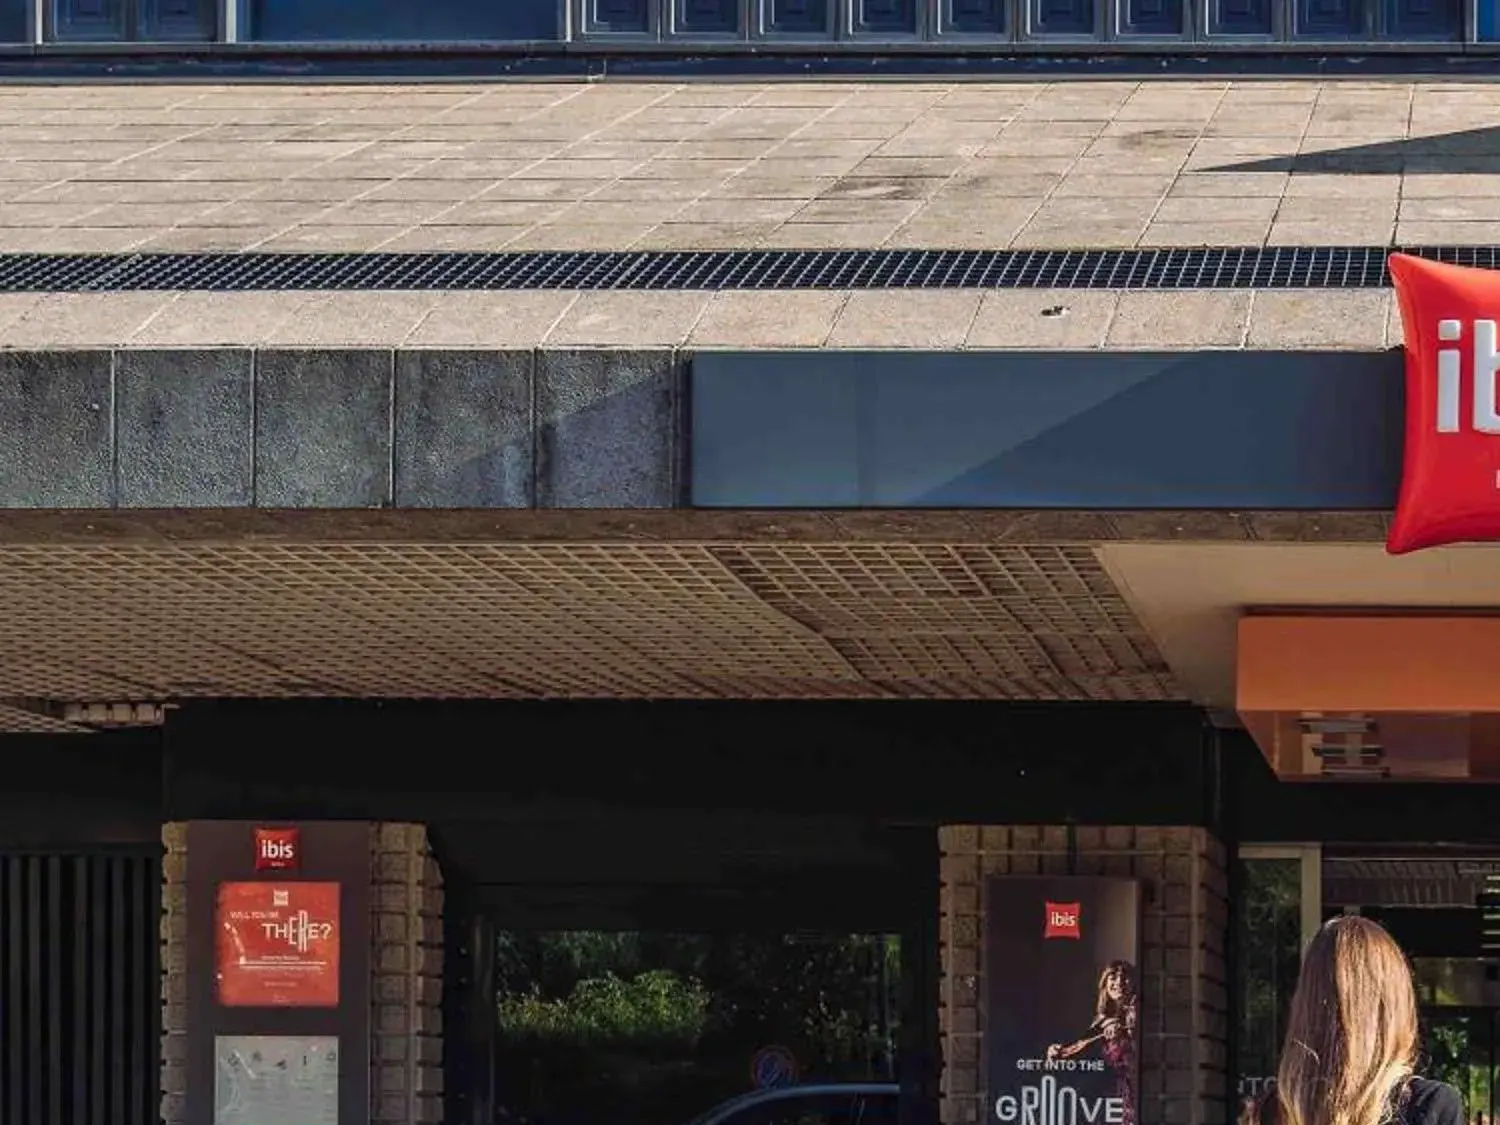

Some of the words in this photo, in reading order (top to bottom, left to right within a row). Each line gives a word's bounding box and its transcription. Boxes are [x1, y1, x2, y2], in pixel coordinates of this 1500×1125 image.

[261, 839, 294, 859] ibis
[1051, 911, 1076, 927] ibis
[1016, 1059, 1042, 1071] GET
[1044, 1059, 1077, 1071] INTO
[1079, 1059, 1105, 1071] THE
